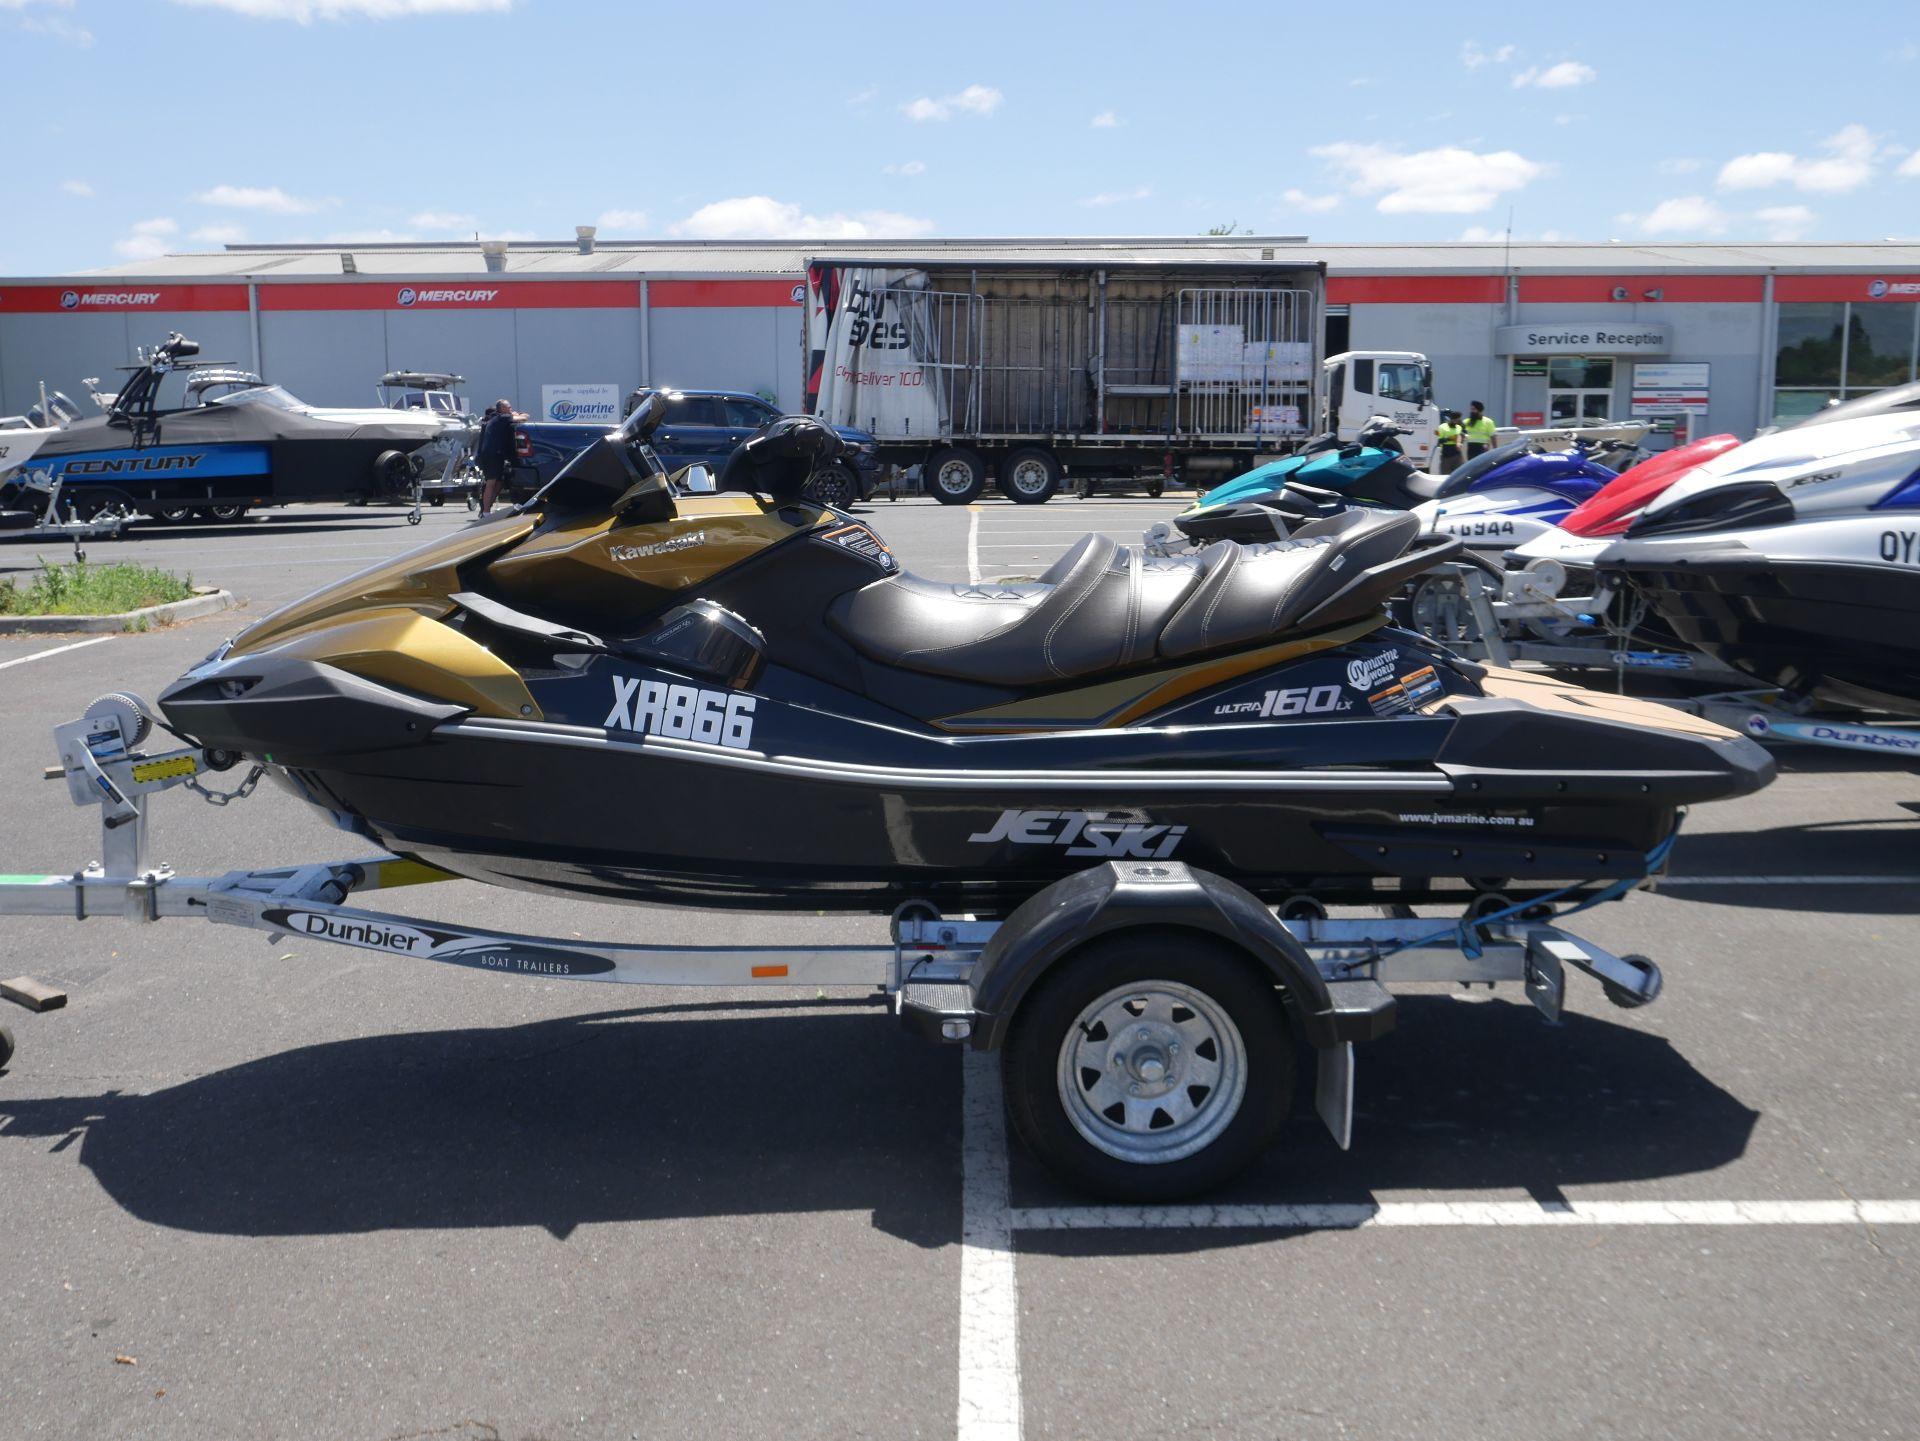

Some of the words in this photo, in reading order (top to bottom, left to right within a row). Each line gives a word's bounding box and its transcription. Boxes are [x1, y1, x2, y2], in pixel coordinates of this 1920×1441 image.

[81, 293, 160, 305] MERCURY
[417, 290, 498, 302] MERCURY
[1528, 332, 1590, 346] Service
[1596, 331, 1664, 347] Reception
[572, 402, 616, 414] marine
[65, 455, 206, 475] CENTURY
[610, 530, 705, 562] Kawasaki
[1364, 648, 1399, 671] marine
[1369, 663, 1395, 680] WORLD
[1812, 727, 1918, 749] Dunbier
[305, 914, 420, 951] Dunbier
[481, 955, 509, 968] BOAT
[517, 959, 570, 974] TRAILERS
